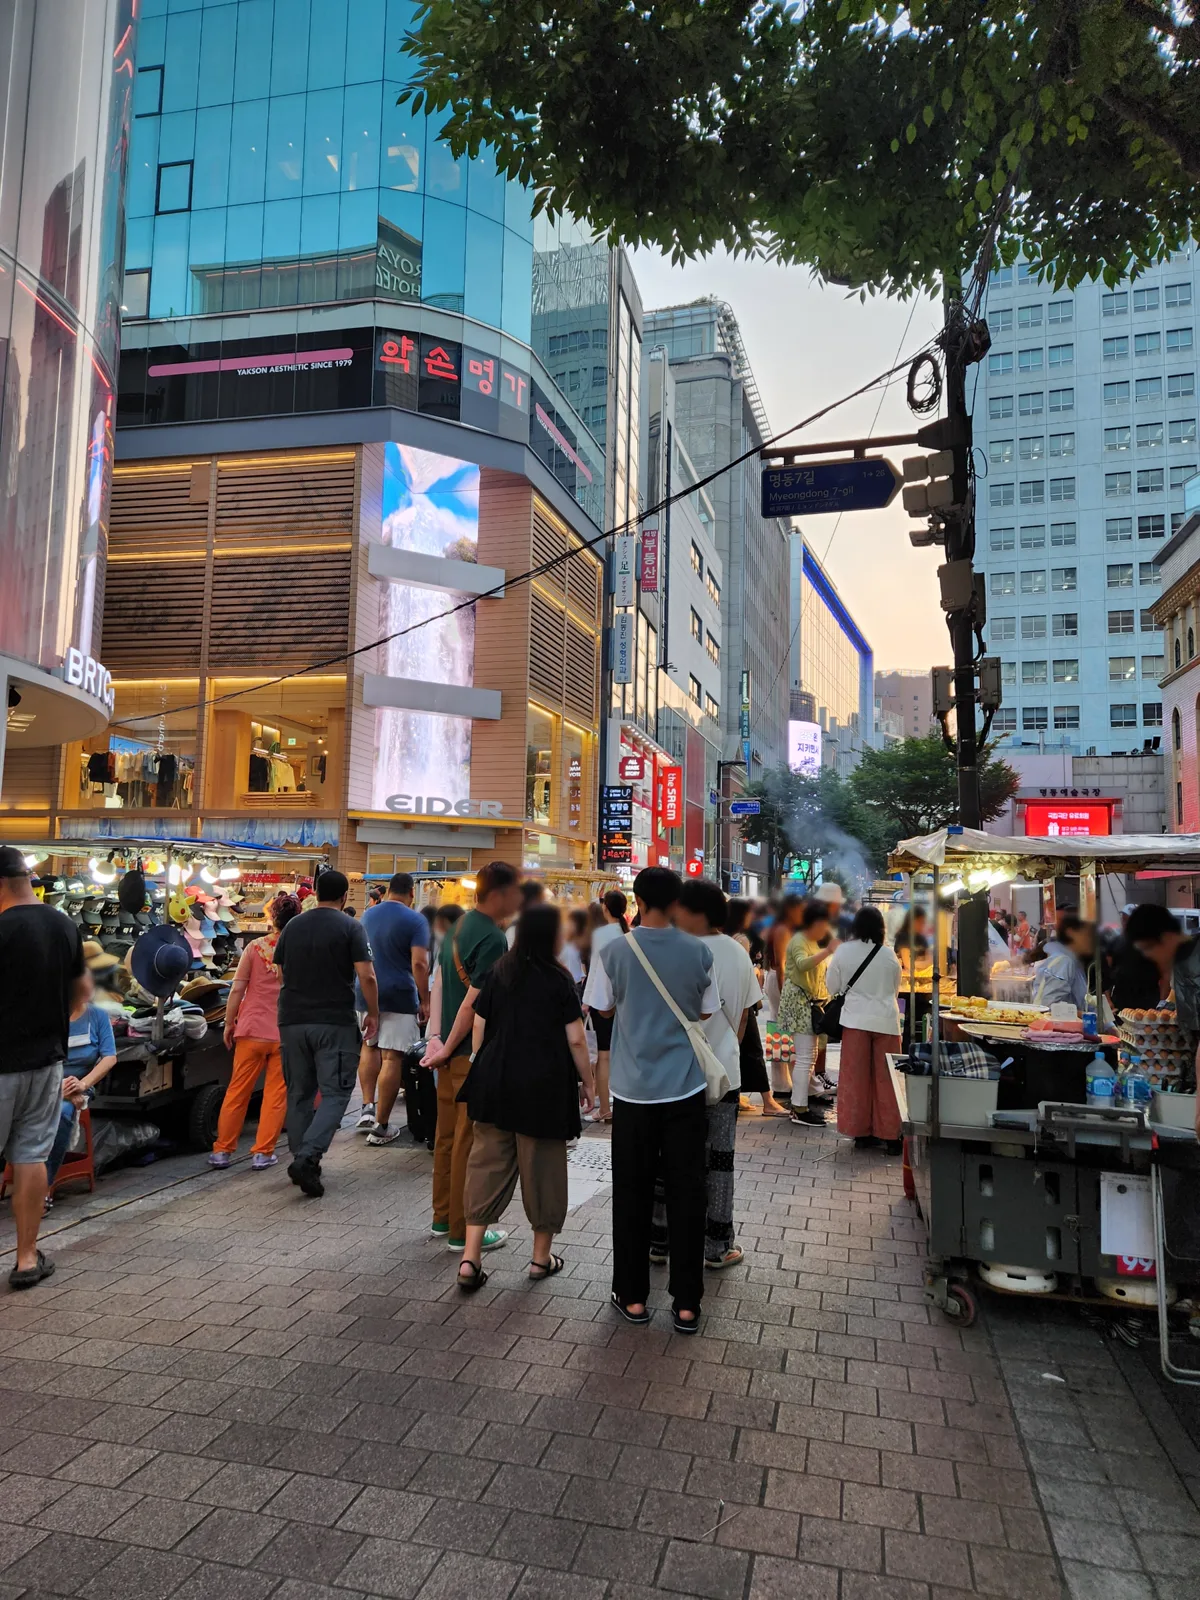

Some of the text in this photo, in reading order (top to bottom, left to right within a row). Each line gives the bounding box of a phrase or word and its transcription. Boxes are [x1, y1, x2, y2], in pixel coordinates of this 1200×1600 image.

[237, 359, 353, 376] YAKSON AESTHETIC SINCE 1979
[379, 335, 527, 407] 약손명가
[769, 470, 815, 488] 명동7길
[769, 486, 854, 502] Myeongdong 7-gil
[643, 538, 657, 579] 부동산
[619, 641, 628, 674] 성형외과
[667, 772, 677, 821] the SAEM
[1039, 788, 1101, 797] 명동예술극장
[385, 793, 505, 819] EIDER
